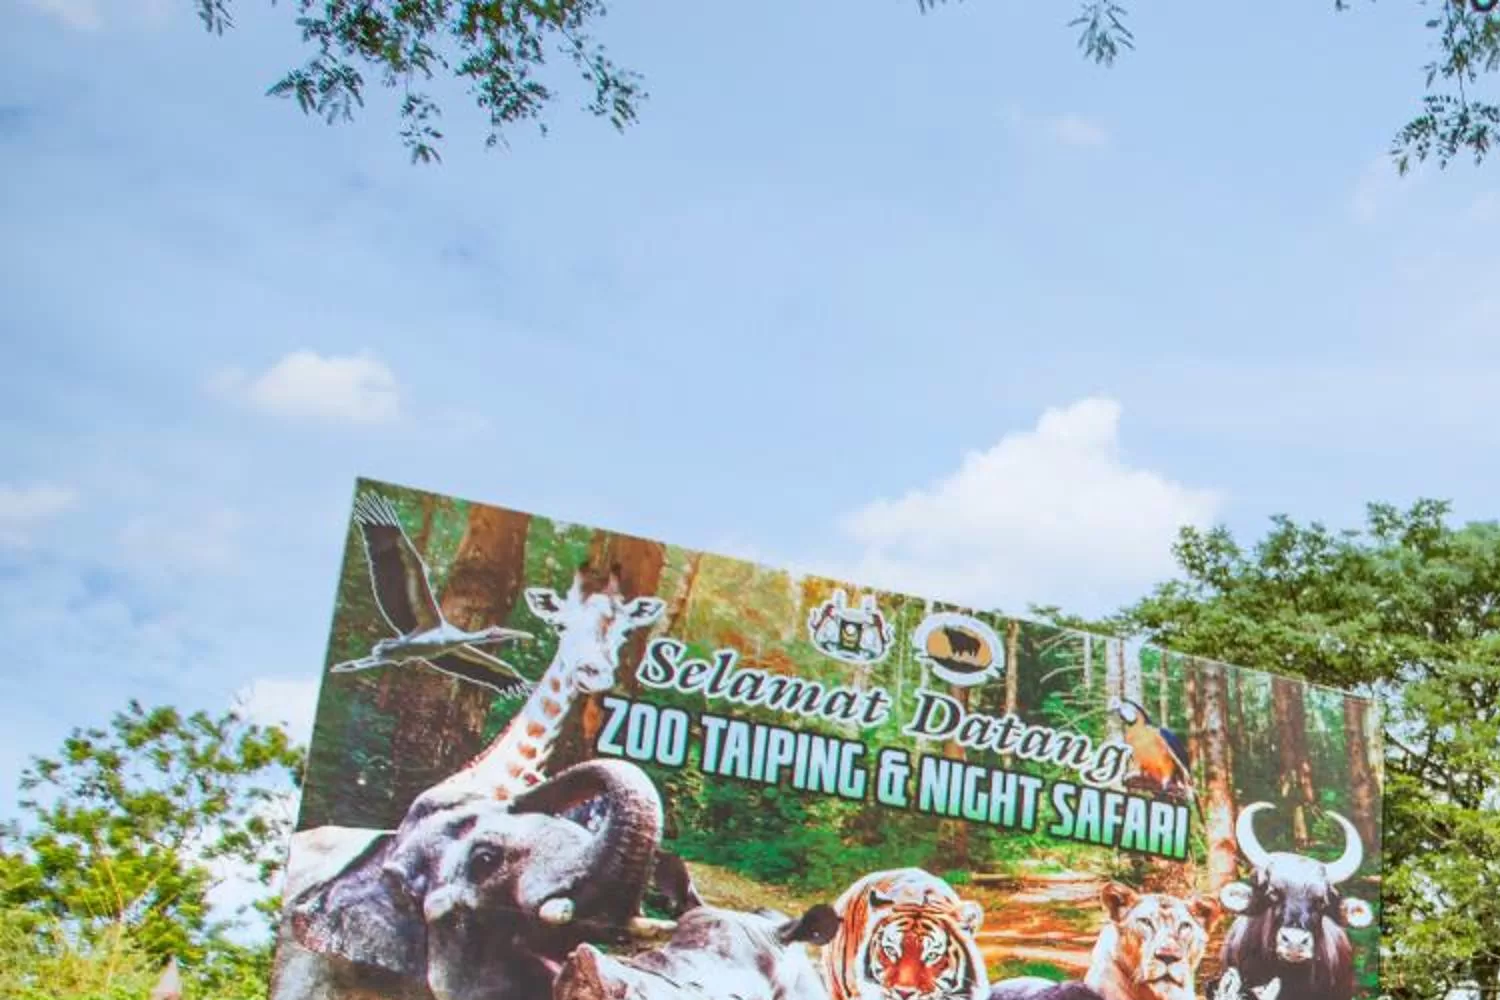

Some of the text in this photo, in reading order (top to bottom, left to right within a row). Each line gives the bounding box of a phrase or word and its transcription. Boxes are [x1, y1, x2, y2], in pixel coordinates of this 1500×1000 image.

[597, 697, 1189, 860] ZOO TAIPING & NIGHT SAFARI
[638, 638, 1136, 786] Selamat Datang
